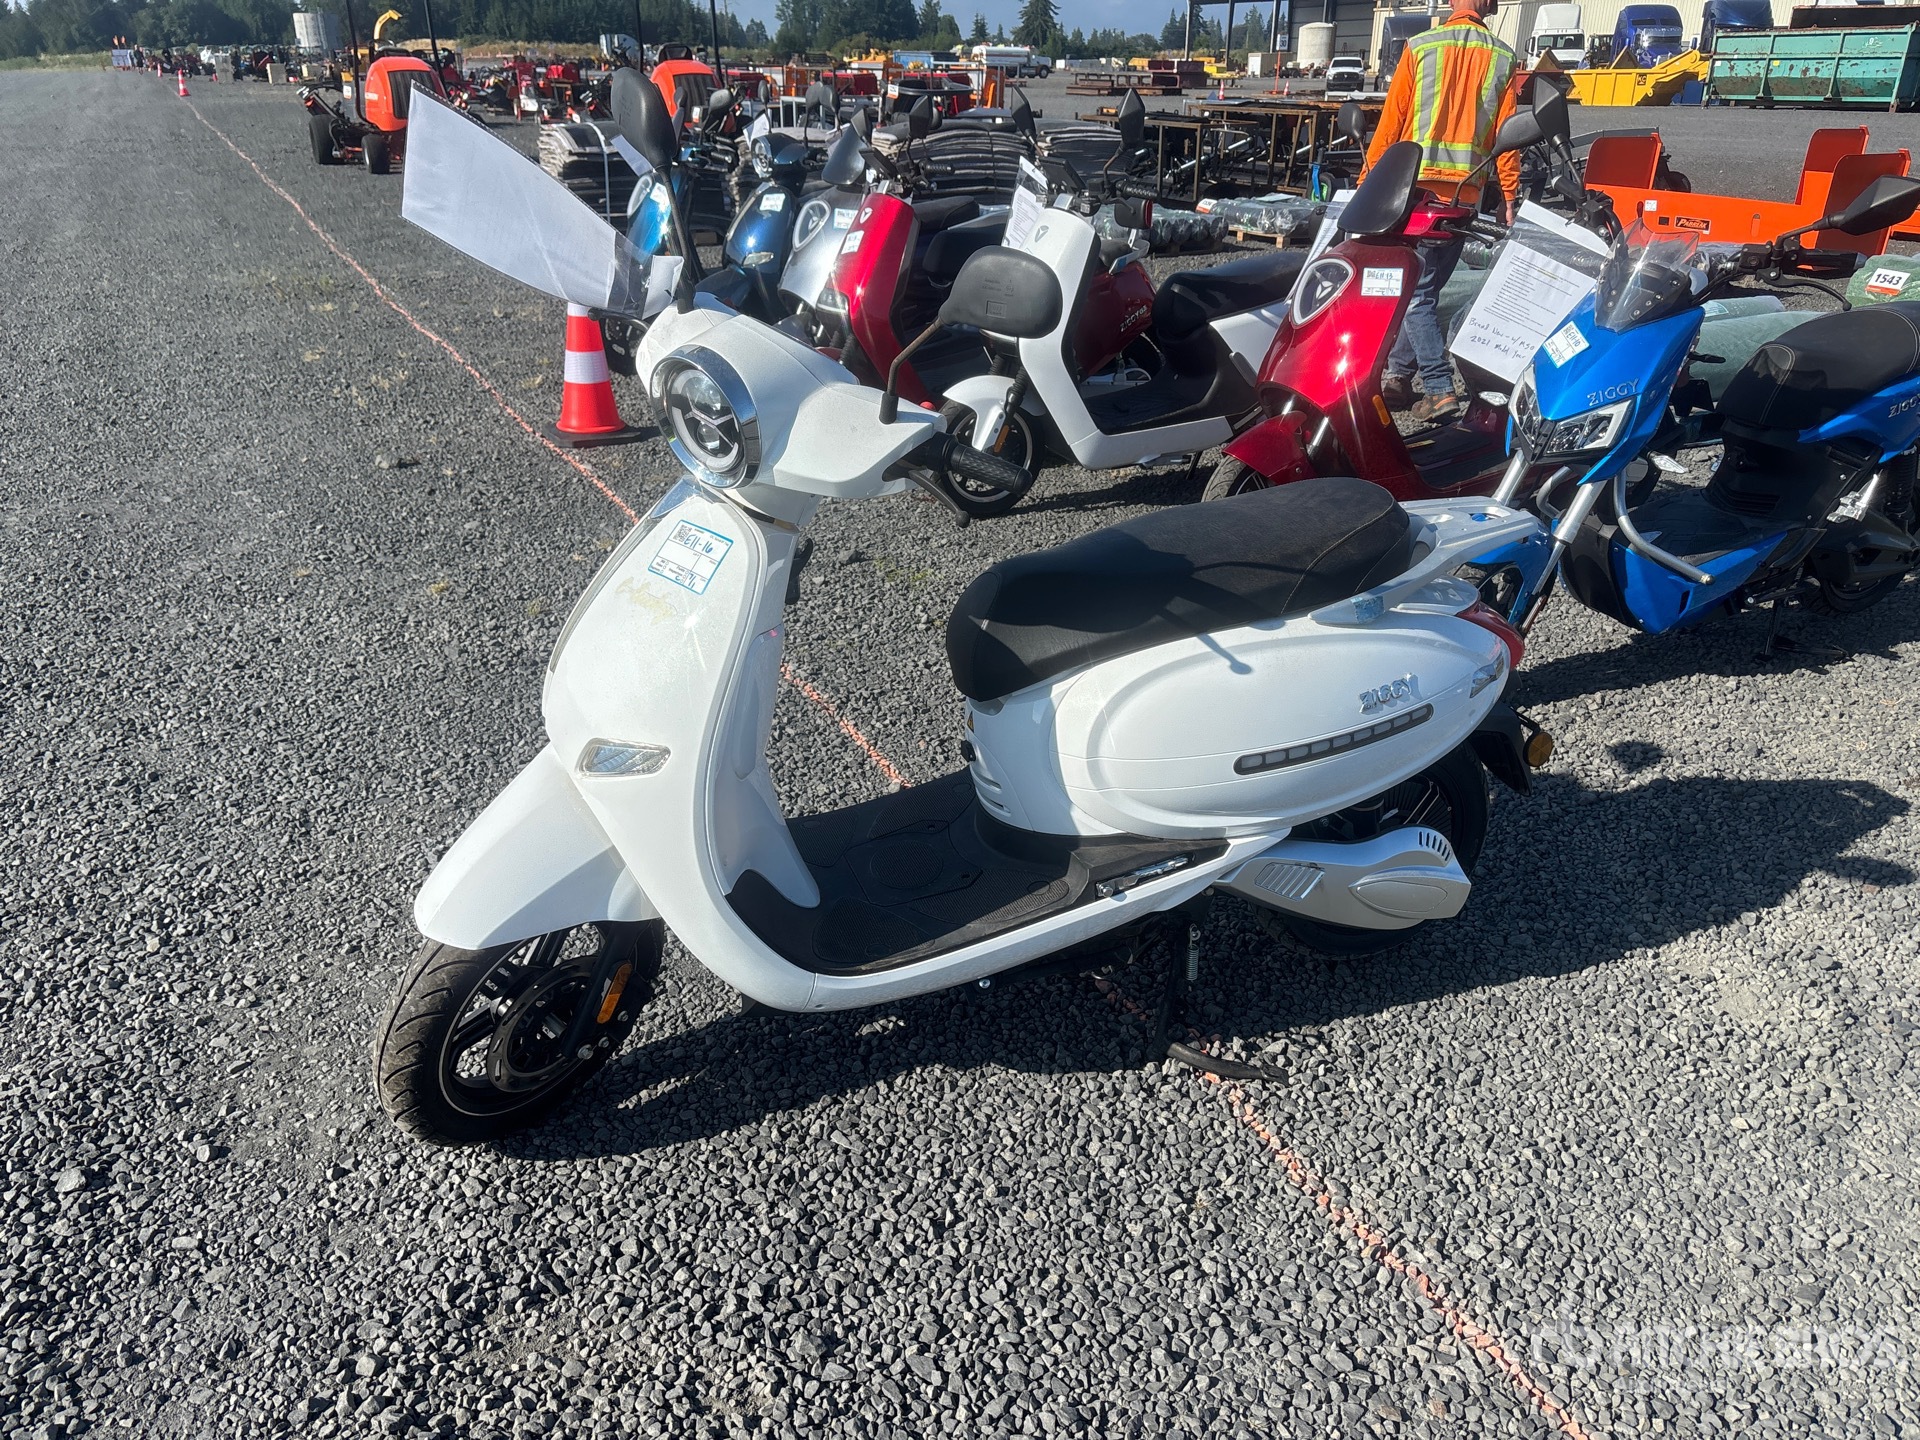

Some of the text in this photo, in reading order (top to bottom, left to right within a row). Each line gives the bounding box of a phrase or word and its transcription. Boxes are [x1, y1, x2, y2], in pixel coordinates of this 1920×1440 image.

[1874, 273, 1902, 286] 1543
[1470, 335, 1491, 346] 2021
[1587, 378, 1639, 406] ZIGGY
[684, 534, 713, 554] E11-16
[1359, 674, 1412, 713] ZIGGY
